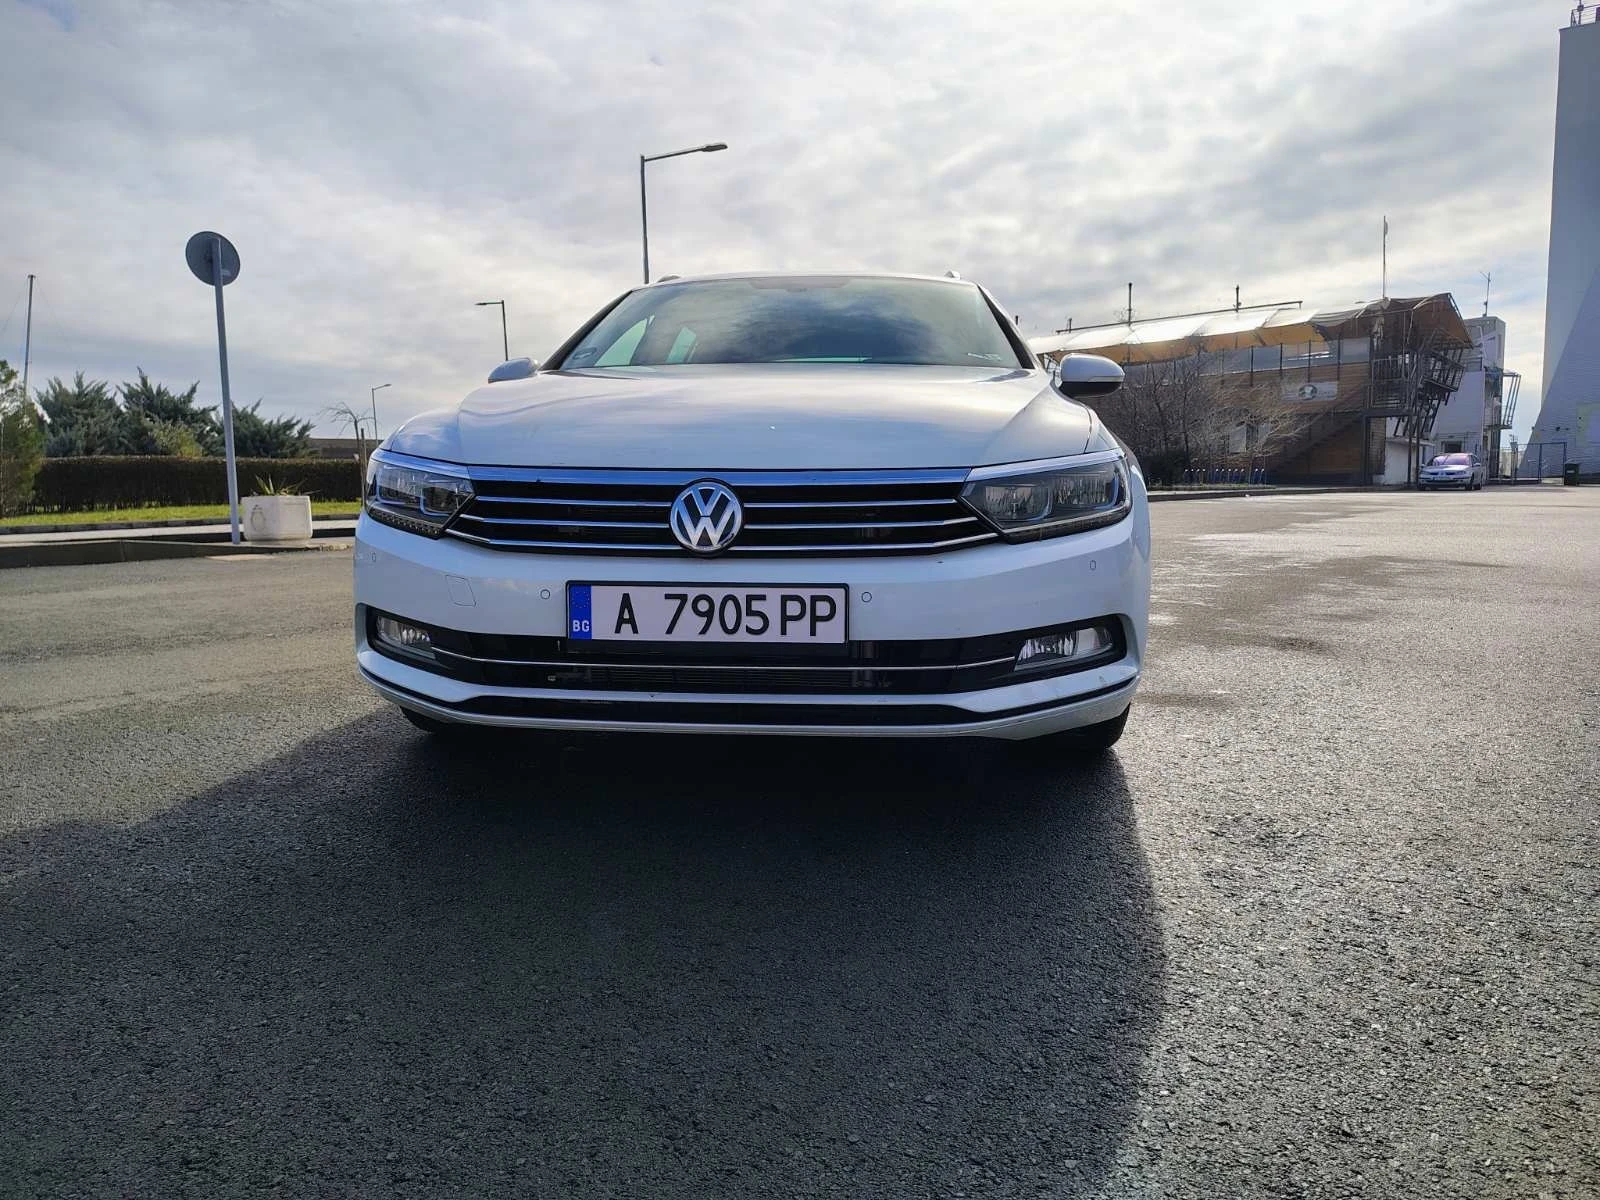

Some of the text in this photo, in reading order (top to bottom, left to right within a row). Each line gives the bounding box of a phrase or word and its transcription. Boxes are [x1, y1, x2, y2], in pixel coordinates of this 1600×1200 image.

[673, 484, 738, 549] VW
[572, 620, 590, 632] BG
[614, 593, 639, 634] A
